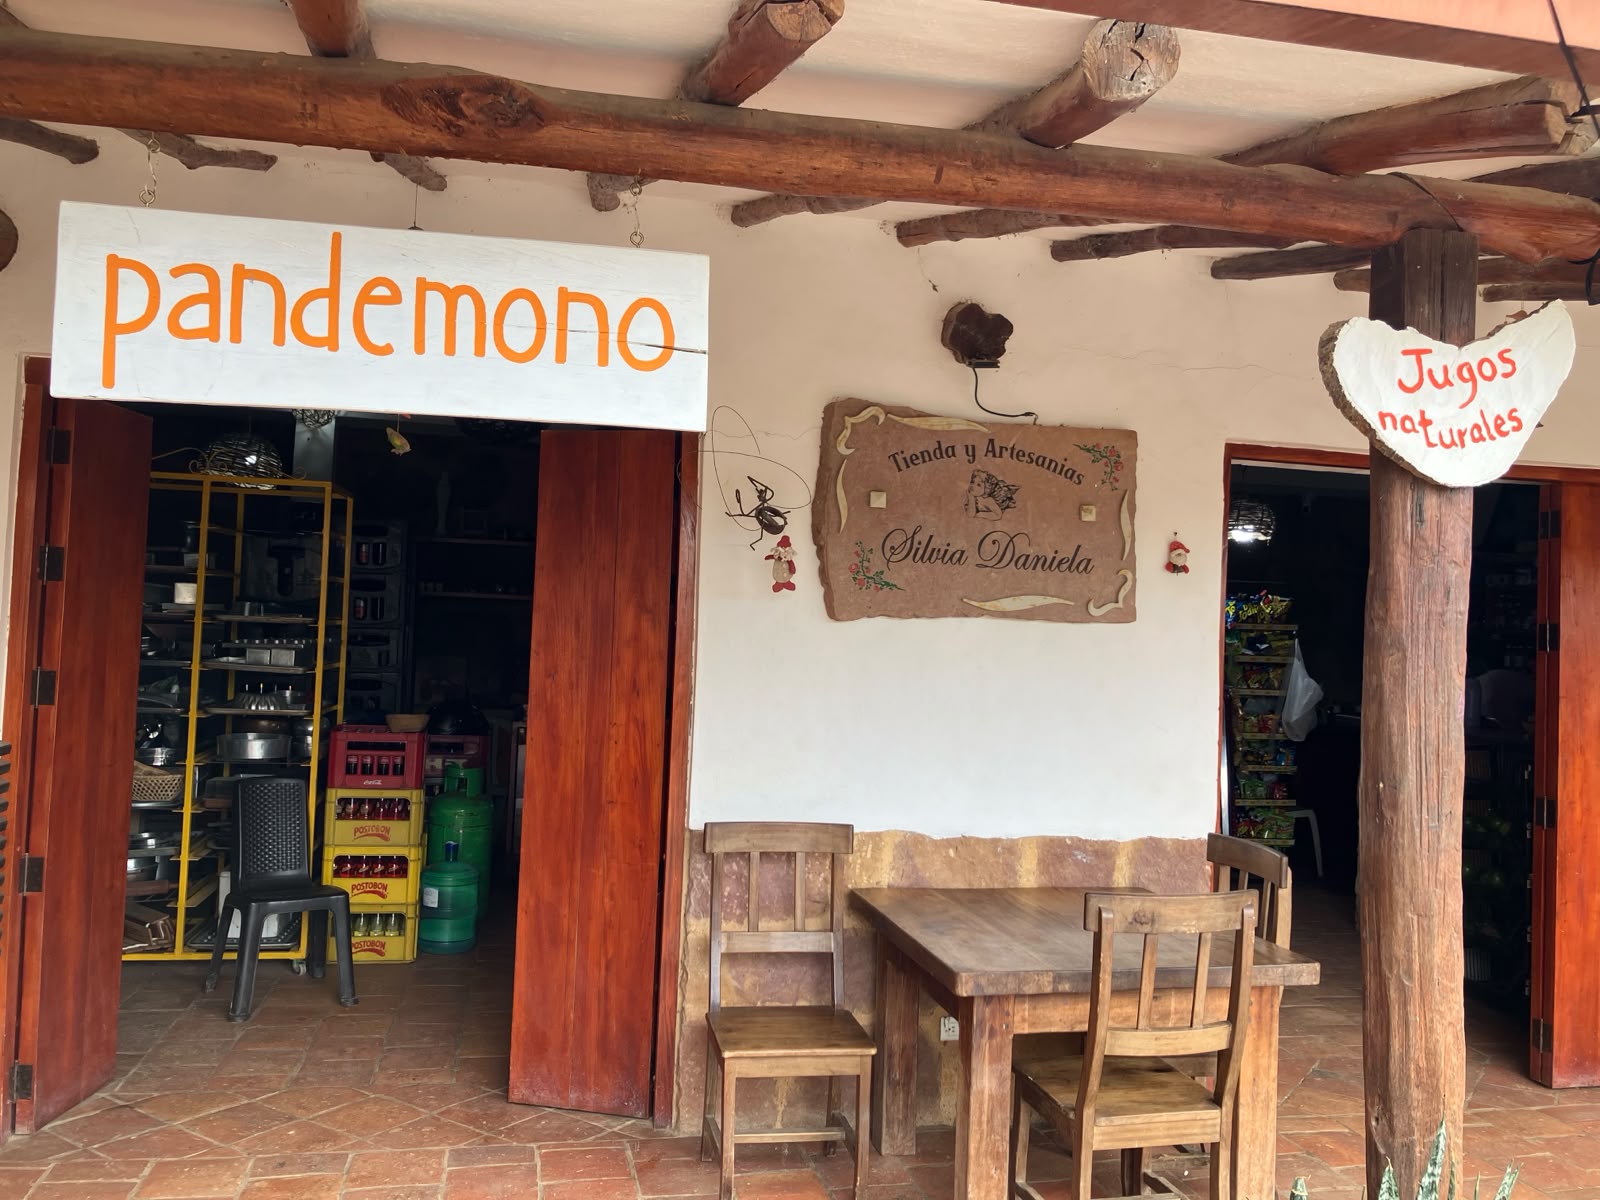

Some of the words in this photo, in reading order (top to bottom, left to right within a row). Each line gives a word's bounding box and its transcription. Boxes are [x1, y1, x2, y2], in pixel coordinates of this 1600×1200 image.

[102, 231, 676, 389] pandemono
[1397, 348, 1517, 410] Jugos
[1378, 407, 1524, 450] naturales
[888, 439, 957, 473] Tienda
[964, 443, 976, 464] y
[984, 438, 1086, 486] Artesanias
[881, 525, 969, 571] Silvia
[975, 529, 1096, 575] Daniela
[351, 881, 389, 893] POSTOBON
